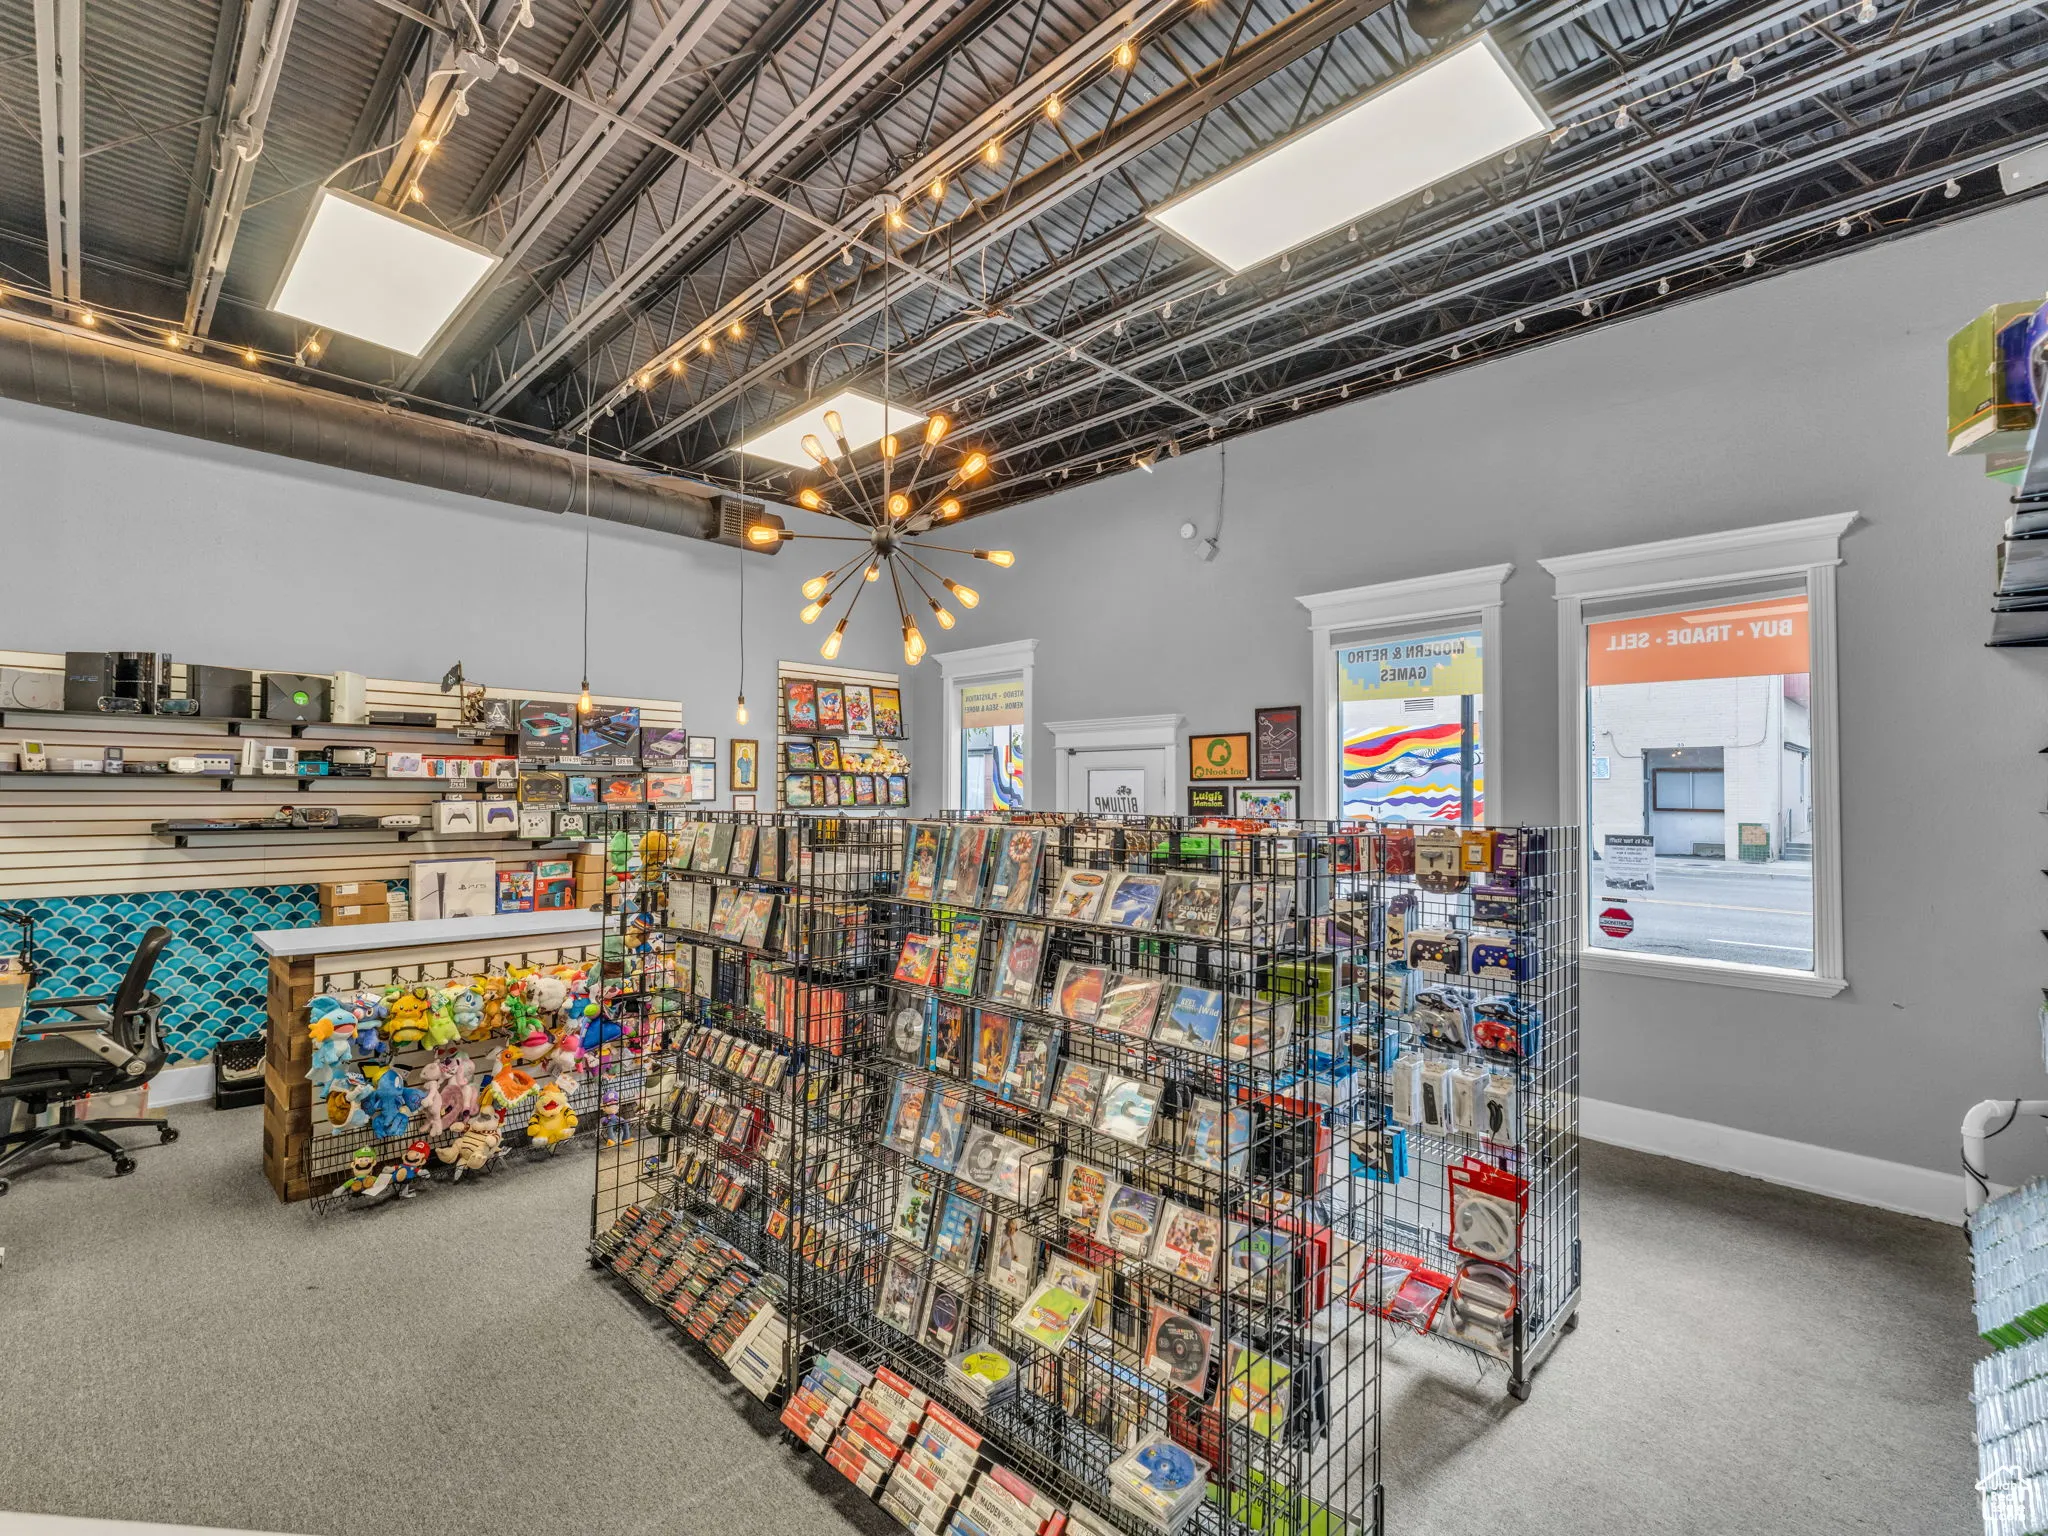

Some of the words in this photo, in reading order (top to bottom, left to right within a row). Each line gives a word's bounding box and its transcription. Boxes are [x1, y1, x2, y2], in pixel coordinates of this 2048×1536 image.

[1205, 768, 1227, 776] Nook
[1193, 792, 1223, 801] Luigi's
[1177, 910, 1217, 920] ZONE
[1179, 904, 1217, 914] CONFLICT
[864, 1390, 879, 1408] Clue
[931, 1425, 950, 1444] SOCCER
[980, 1496, 1002, 1520] MADDEN
[970, 1507, 992, 1528] MADDEN
